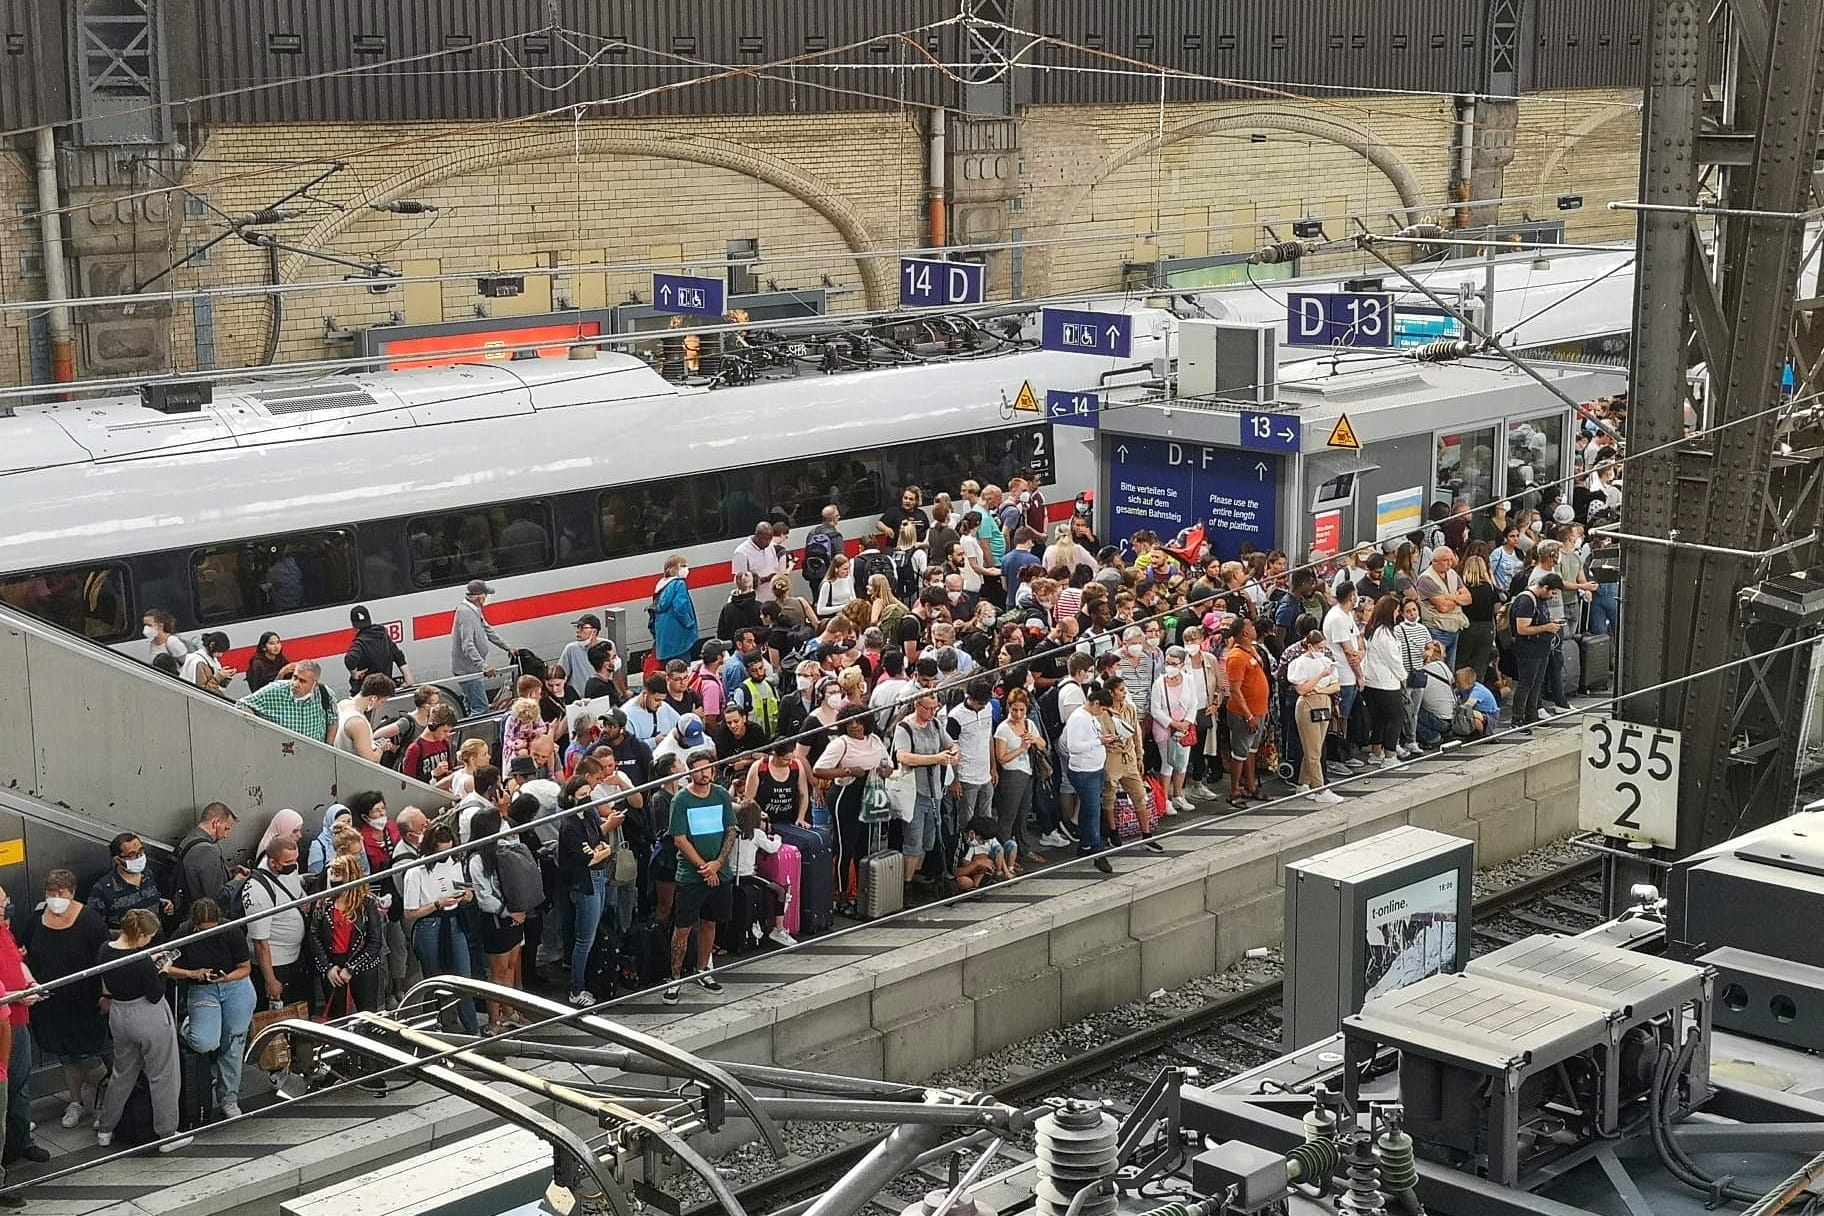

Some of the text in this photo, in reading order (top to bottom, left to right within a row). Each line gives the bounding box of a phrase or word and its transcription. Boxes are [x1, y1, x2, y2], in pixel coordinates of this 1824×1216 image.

[905, 263, 969, 303] 14 D
[1300, 297, 1382, 336] D 13
[1071, 396, 1088, 417] 14
[1250, 416, 1271, 438] 13
[1033, 432, 1045, 456] 2
[1168, 443, 1183, 466] D
[1202, 447, 1214, 470] F
[1120, 481, 1178, 498] Bitte verteilen Sie
[1127, 495, 1170, 508] sich auf dem
[1209, 494, 1259, 509] Please use the
[1115, 505, 1182, 523] gesamten Bahnsteig
[1212, 508, 1256, 521] entire length
[1208, 518, 1259, 533] of the platform
[1588, 723, 1674, 781] 355
[1613, 782, 1642, 831] 2
